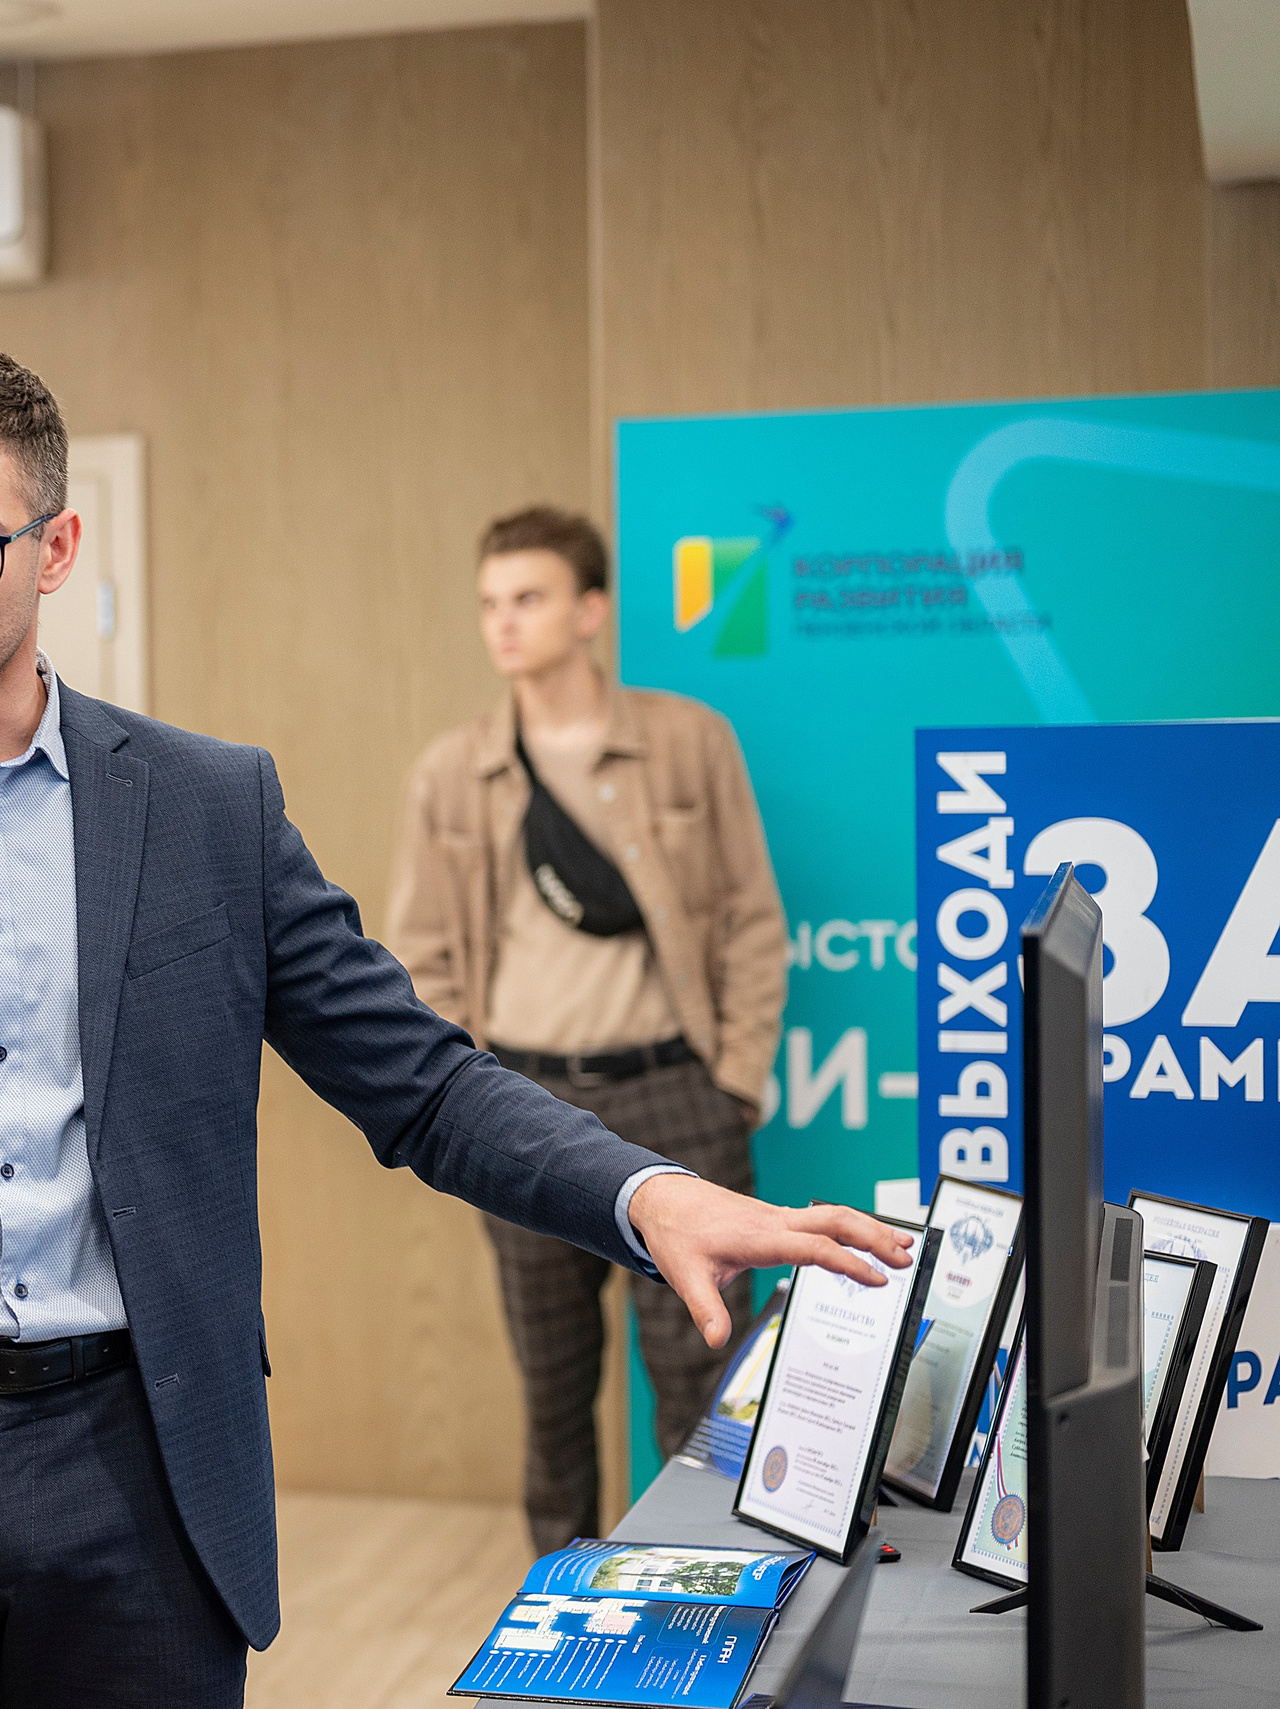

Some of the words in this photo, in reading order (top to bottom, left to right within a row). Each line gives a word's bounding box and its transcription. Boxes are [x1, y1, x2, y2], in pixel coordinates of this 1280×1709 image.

[794, 547, 1024, 578] КОРПОРАЦИЯ
[794, 586, 967, 609] РАЗВИТИЯ
[936, 751, 1015, 1183] ВЫХОДИ
[1103, 1032, 1280, 1103] РАМ
[815, 1301, 876, 1327] СВИДЕТЕЛЬСТВО
